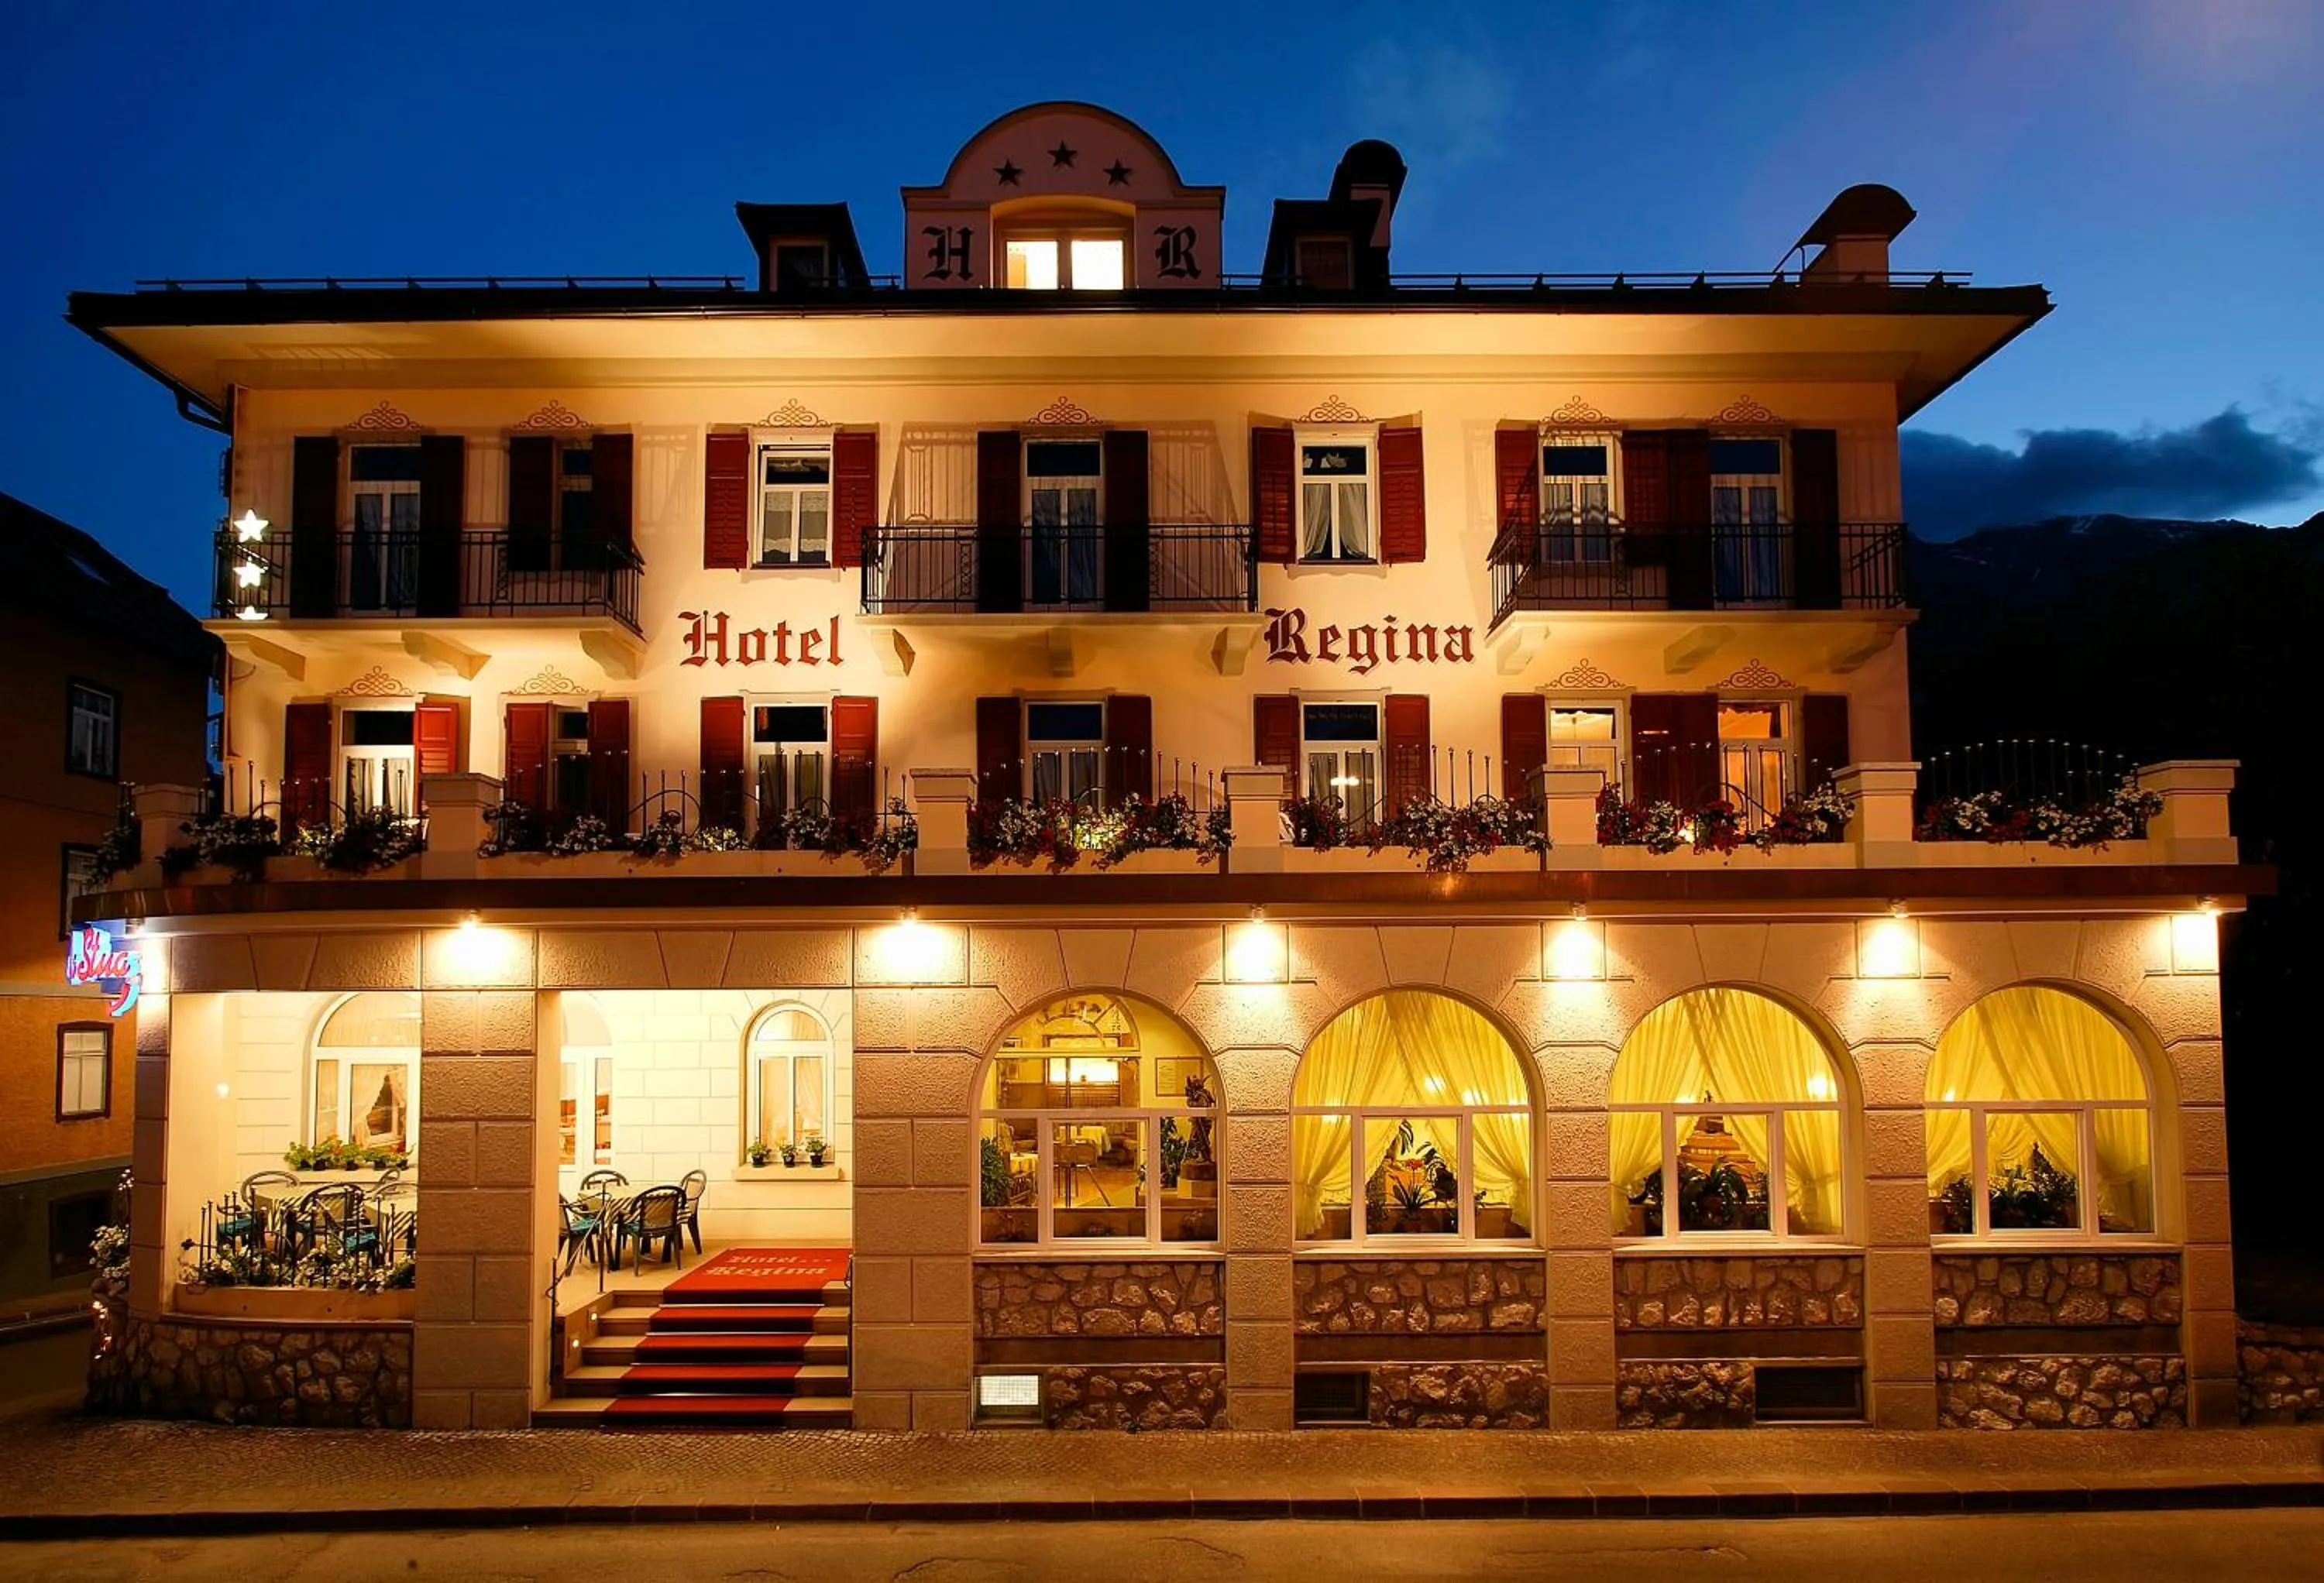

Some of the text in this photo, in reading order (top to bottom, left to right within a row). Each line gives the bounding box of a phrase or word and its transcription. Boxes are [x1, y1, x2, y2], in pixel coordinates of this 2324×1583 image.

[922, 225, 1202, 281] H R
[678, 607, 1475, 675] Hotel Regina
[704, 1265, 827, 1277] Regina
